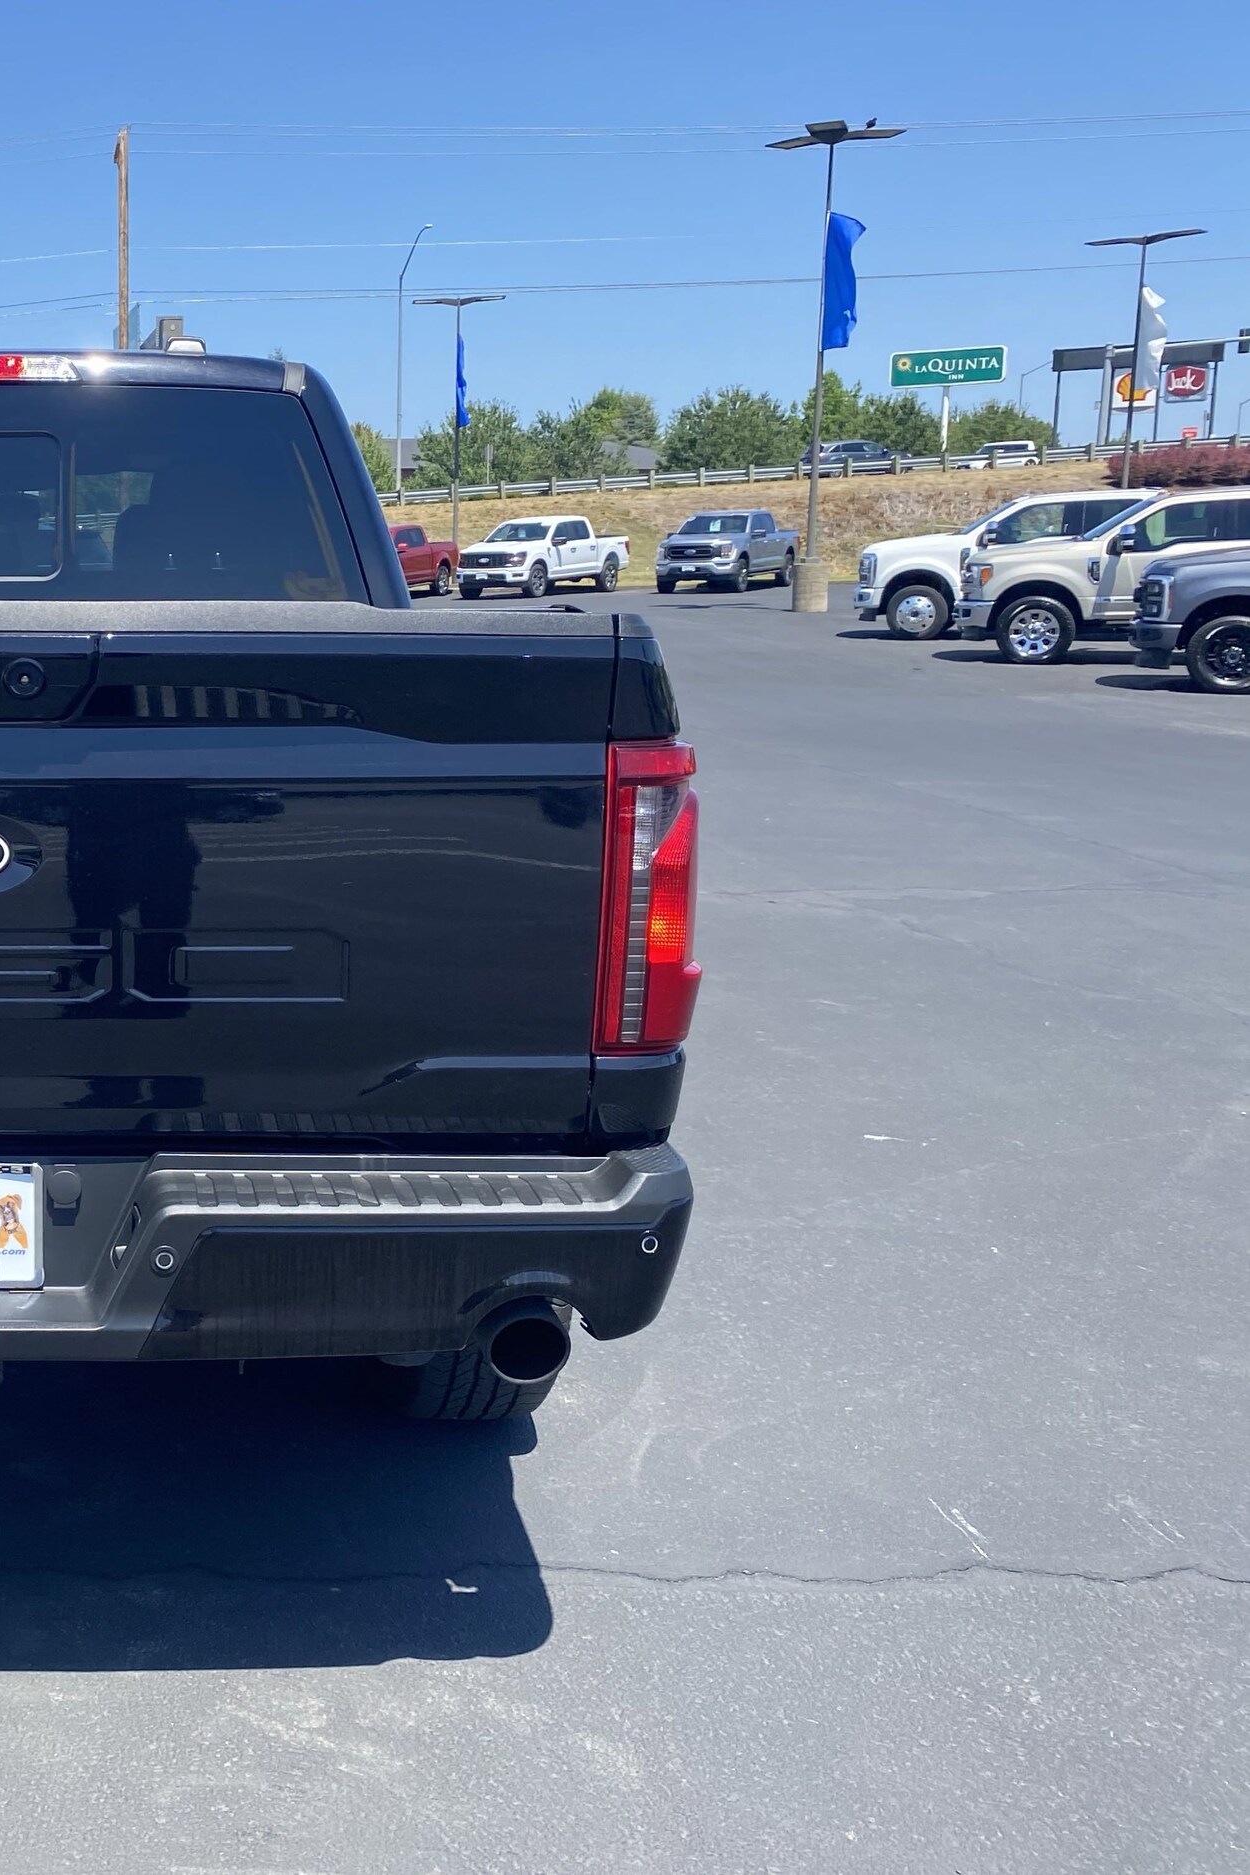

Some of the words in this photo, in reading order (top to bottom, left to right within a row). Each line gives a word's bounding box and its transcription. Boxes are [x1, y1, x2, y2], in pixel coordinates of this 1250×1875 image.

[915, 365, 928, 374] LA
[928, 356, 1000, 375] QUINTA
[1167, 369, 1205, 391] Jack
